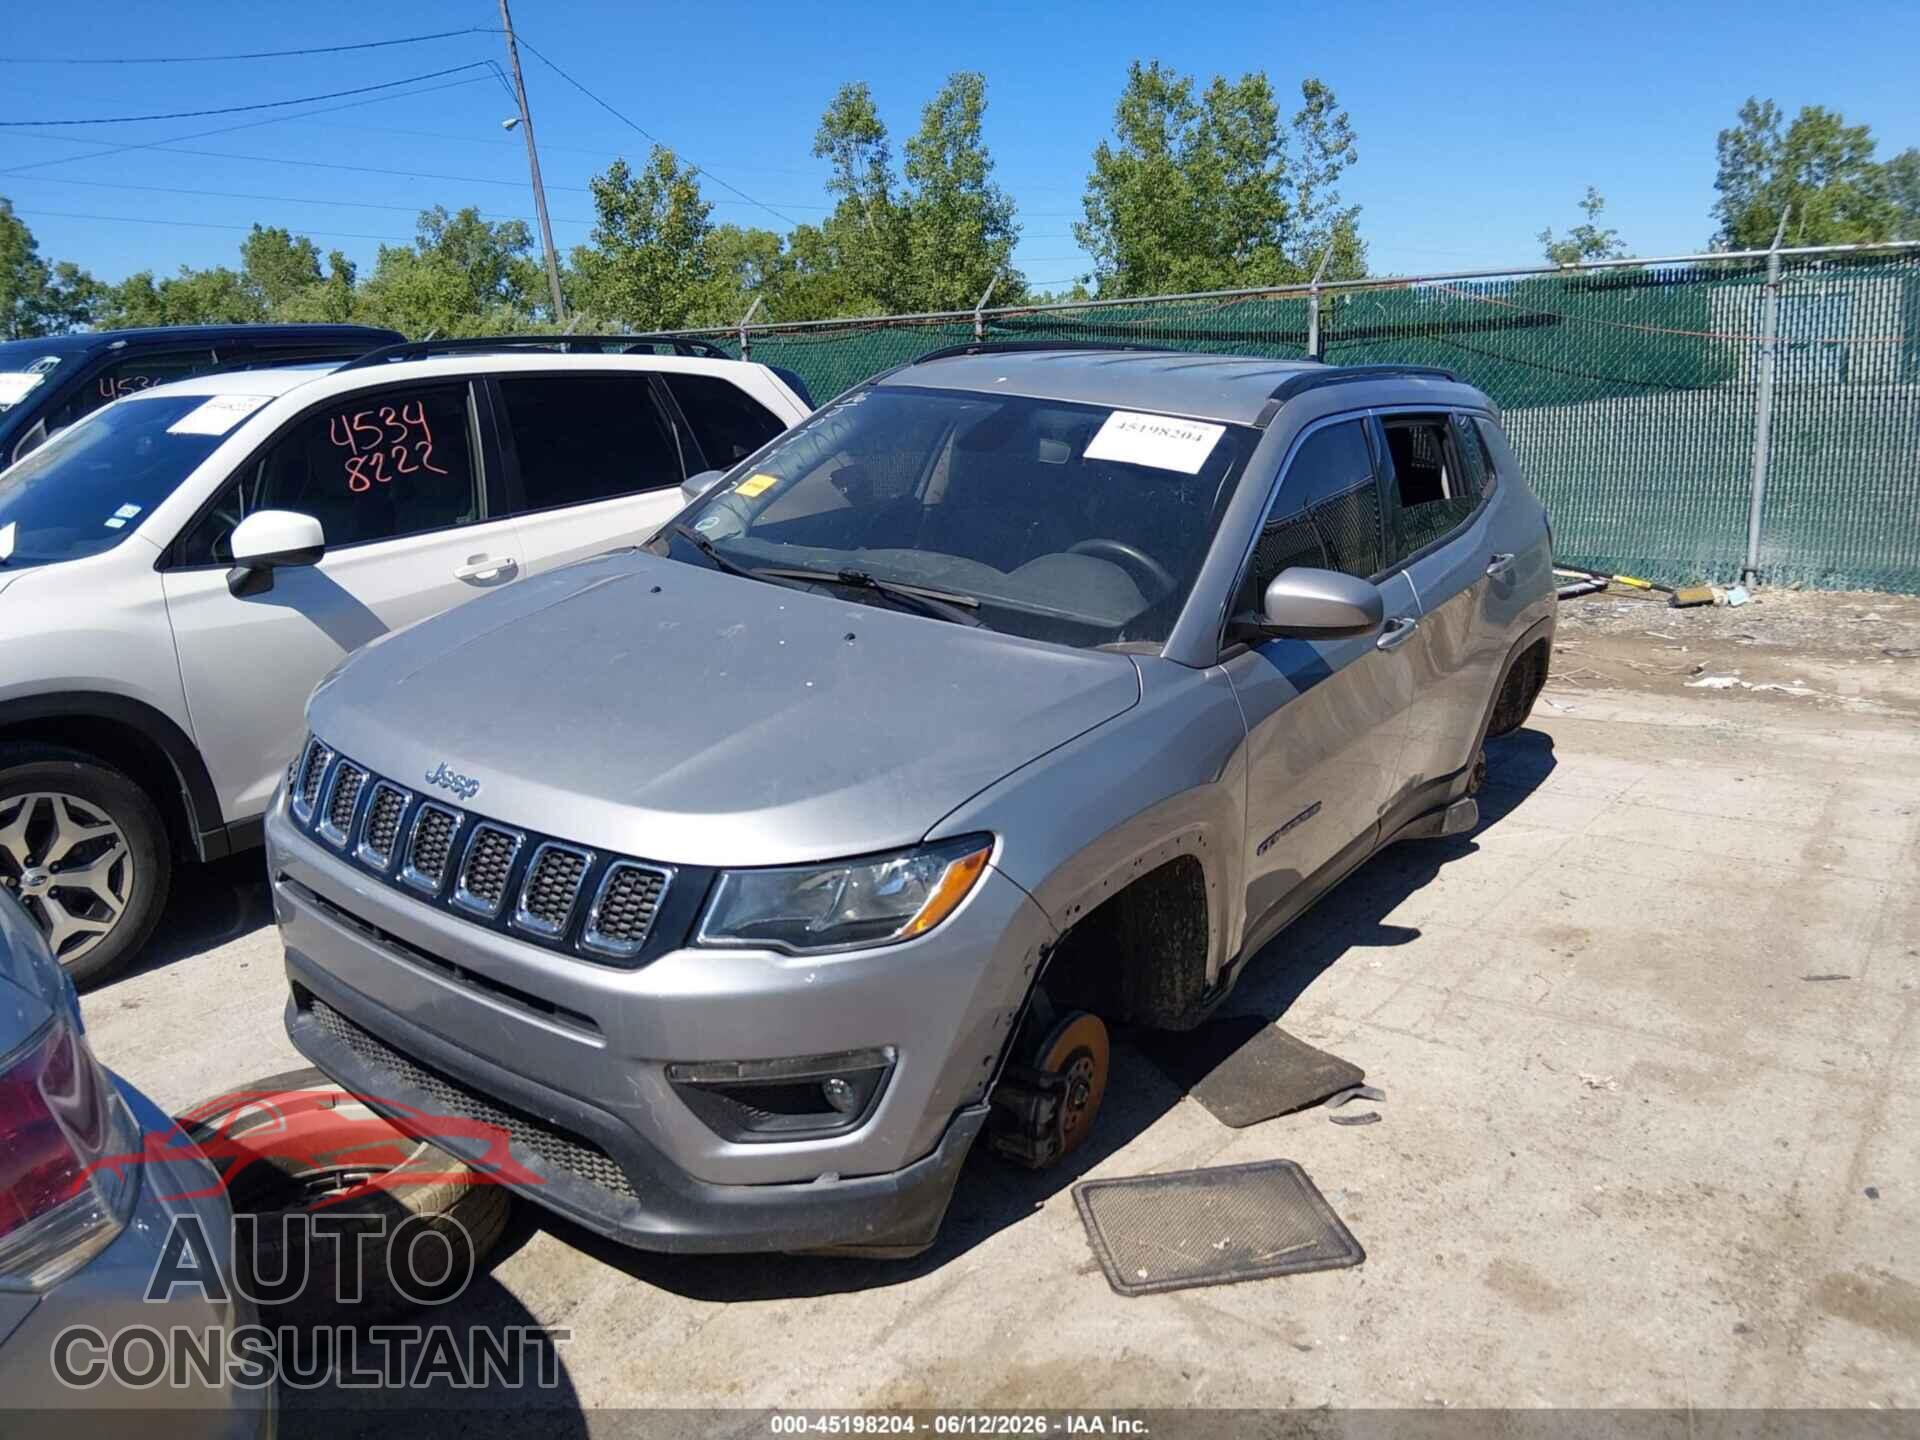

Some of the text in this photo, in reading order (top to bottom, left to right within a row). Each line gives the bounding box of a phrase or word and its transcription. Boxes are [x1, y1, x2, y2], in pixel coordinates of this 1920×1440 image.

[99, 376, 161, 399] 453
[329, 400, 432, 456] 4534
[345, 441, 448, 492] 8222
[425, 761, 480, 800] Jeep
